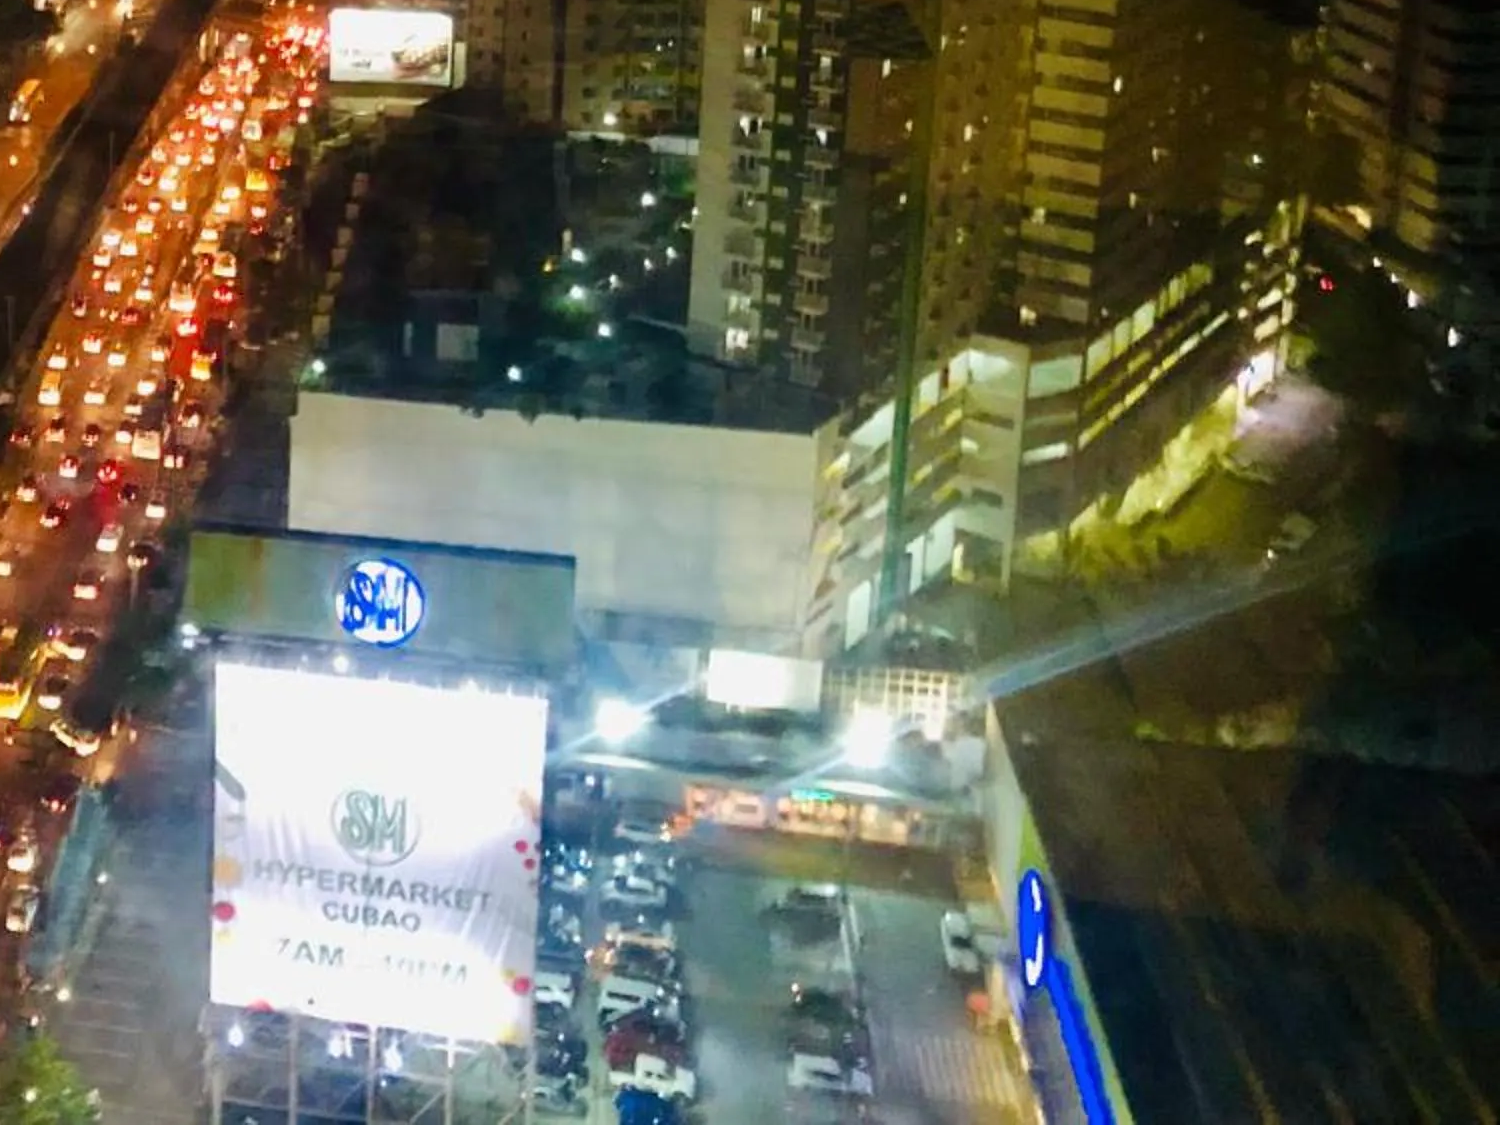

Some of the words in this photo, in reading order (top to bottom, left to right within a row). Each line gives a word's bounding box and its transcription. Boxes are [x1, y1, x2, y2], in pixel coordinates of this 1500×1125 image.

[341, 570, 408, 632] SM
[340, 789, 408, 854] SM
[252, 858, 493, 913] HYPERMARKET
[322, 900, 423, 935] CUBAO
[277, 936, 346, 968] 7AM
